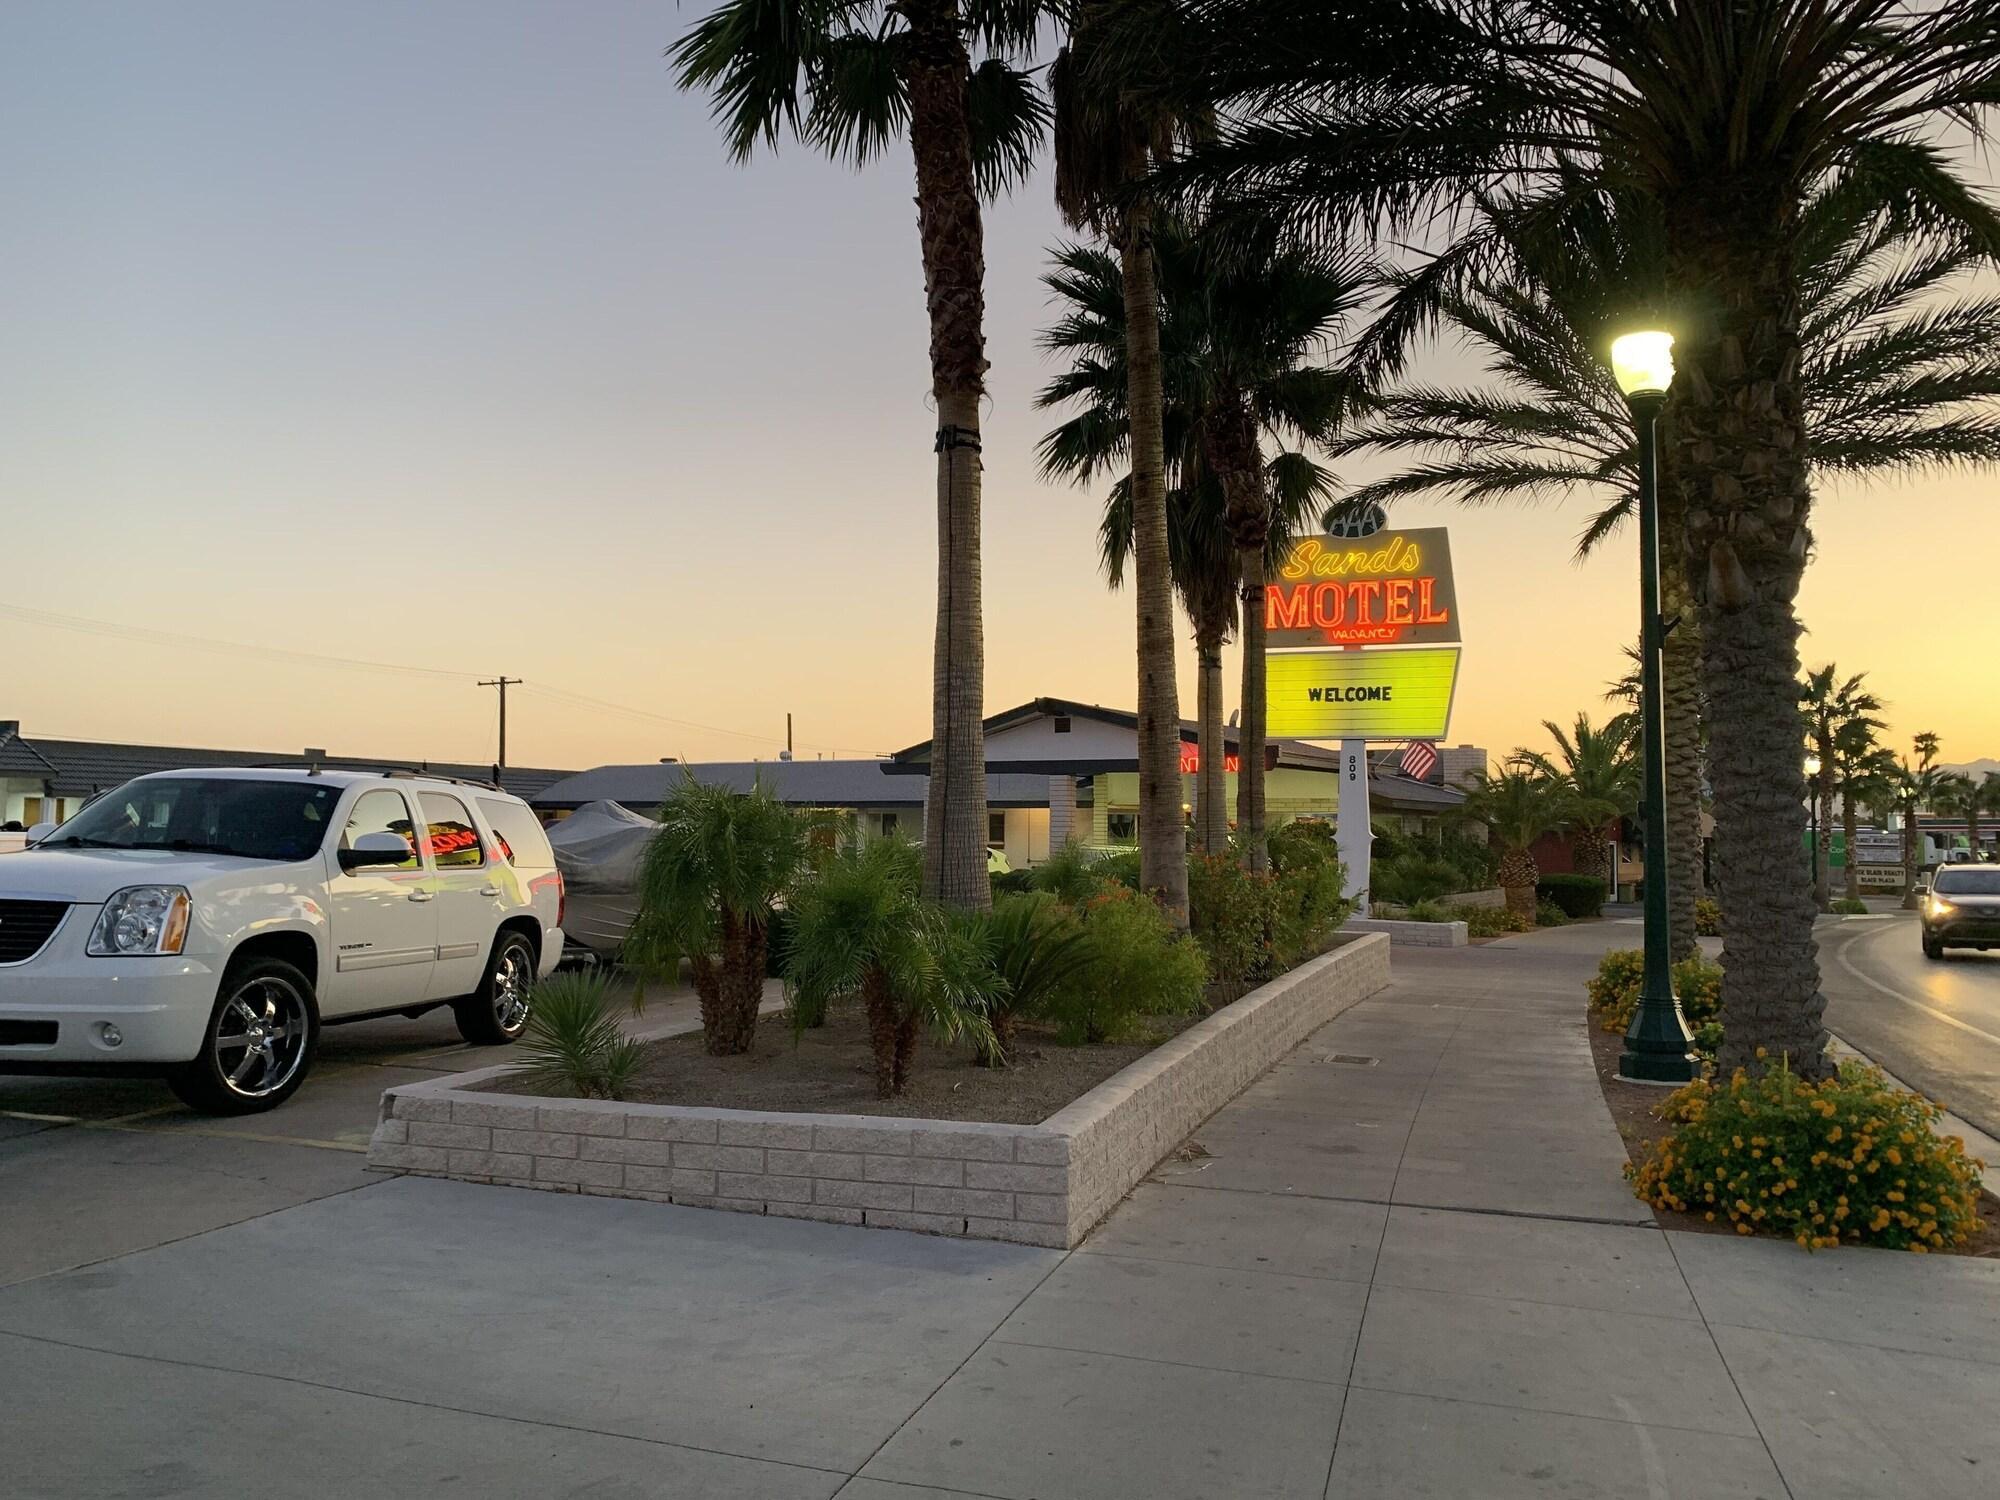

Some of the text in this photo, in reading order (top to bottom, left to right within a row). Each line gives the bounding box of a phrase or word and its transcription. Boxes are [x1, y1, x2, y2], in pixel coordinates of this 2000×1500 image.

[1282, 536, 1421, 578] Sands
[1266, 578, 1448, 629] MOTEL
[1332, 627, 1396, 640] VACANCY
[1308, 686, 1392, 702] WELCOME
[1348, 755, 1357, 782] 809
